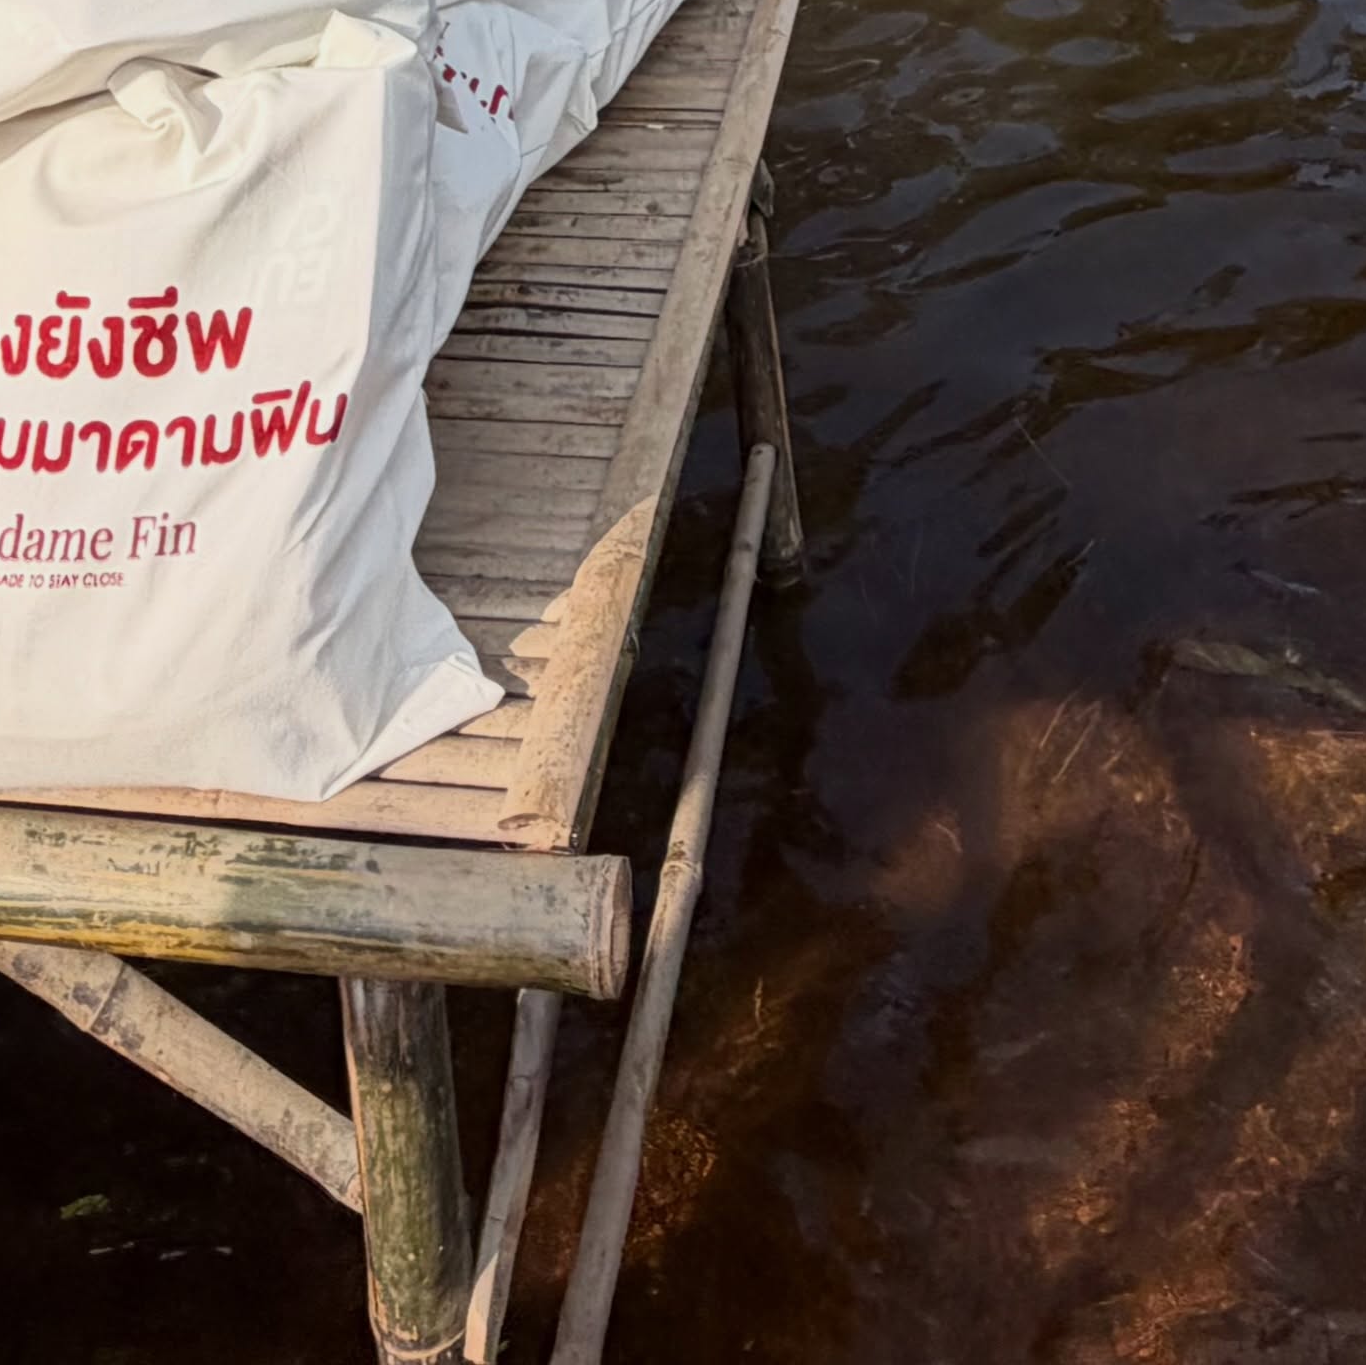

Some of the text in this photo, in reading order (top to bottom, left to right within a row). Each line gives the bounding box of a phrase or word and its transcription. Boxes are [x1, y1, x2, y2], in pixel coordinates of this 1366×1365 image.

[127, 511, 198, 561] Fin
[29, 573, 45, 588] TO
[48, 573, 80, 590] STAY
